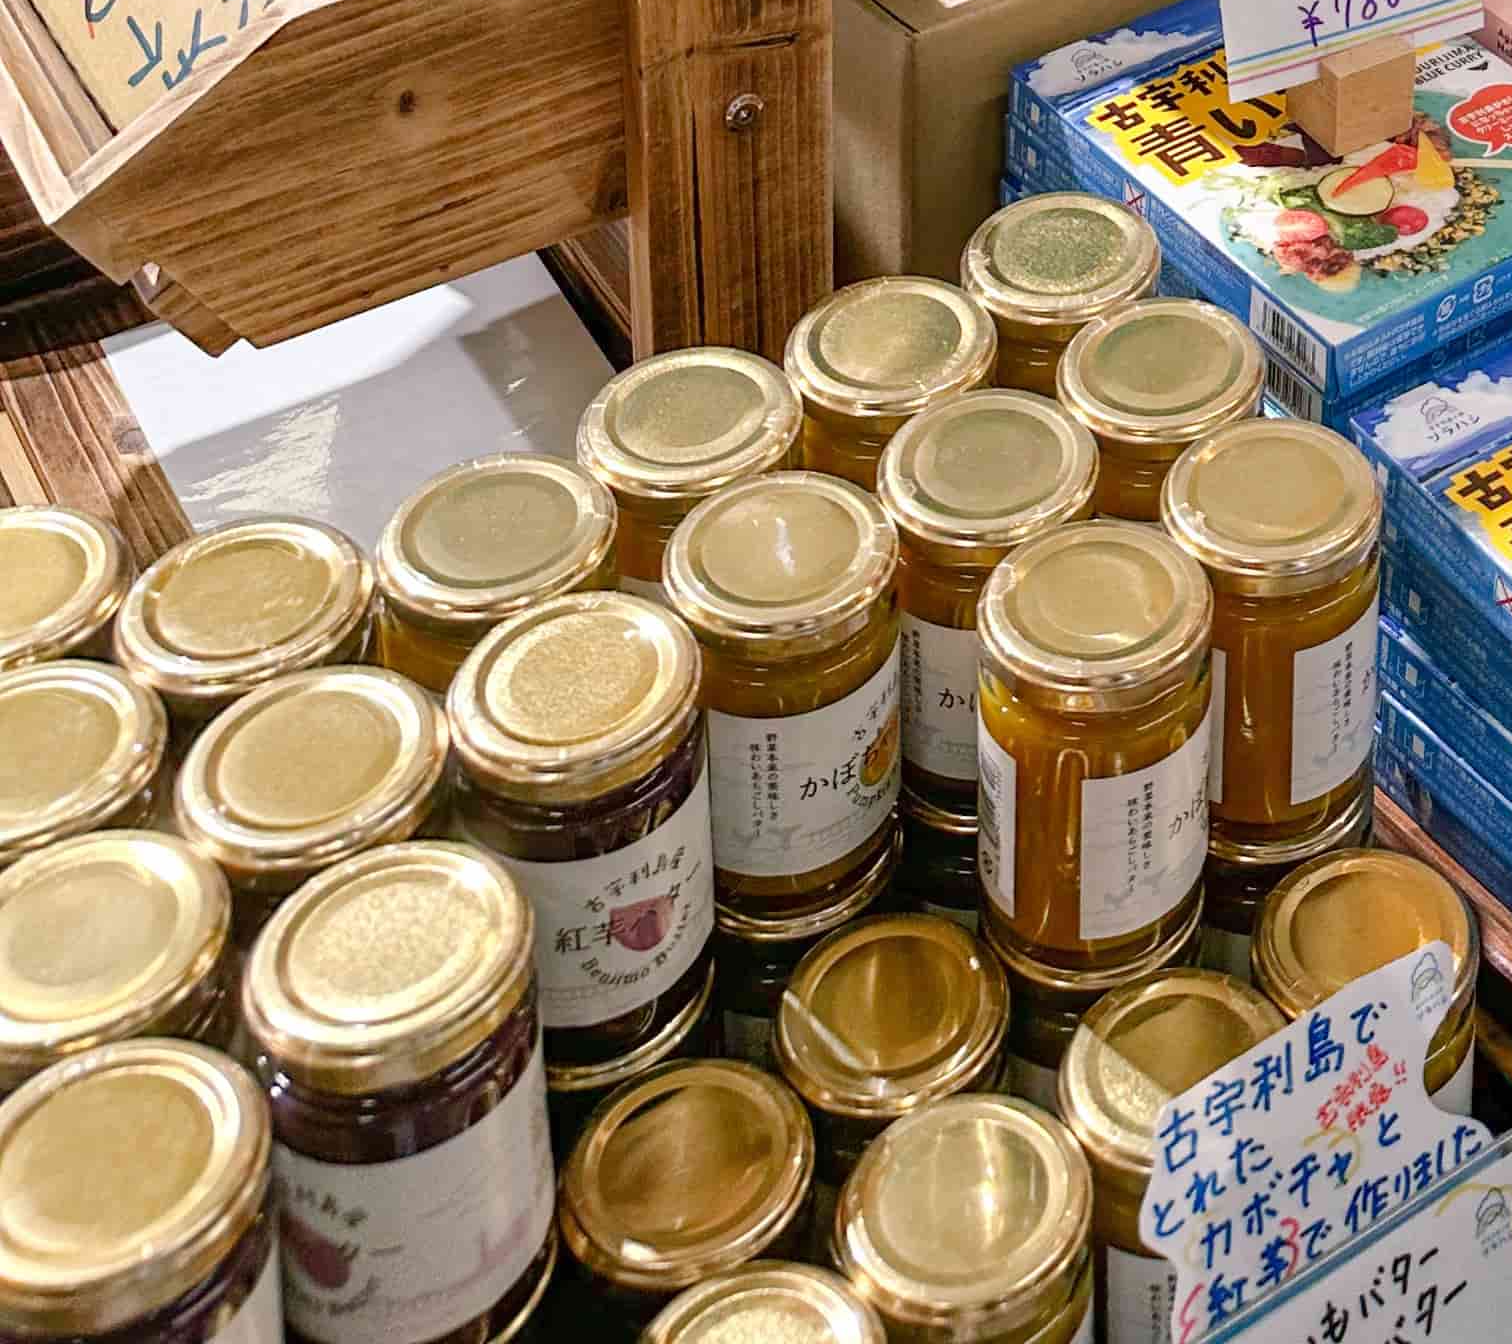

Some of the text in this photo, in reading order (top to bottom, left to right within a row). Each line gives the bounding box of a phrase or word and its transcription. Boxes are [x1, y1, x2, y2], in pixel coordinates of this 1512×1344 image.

[1097, 61, 1228, 131] 古宇利
[1445, 49, 1486, 74] CURRY
[1159, 1001, 1388, 1174] 古宇利島で
[1152, 1135, 1274, 1238] とれた
[1307, 1247, 1440, 1344] もバター
